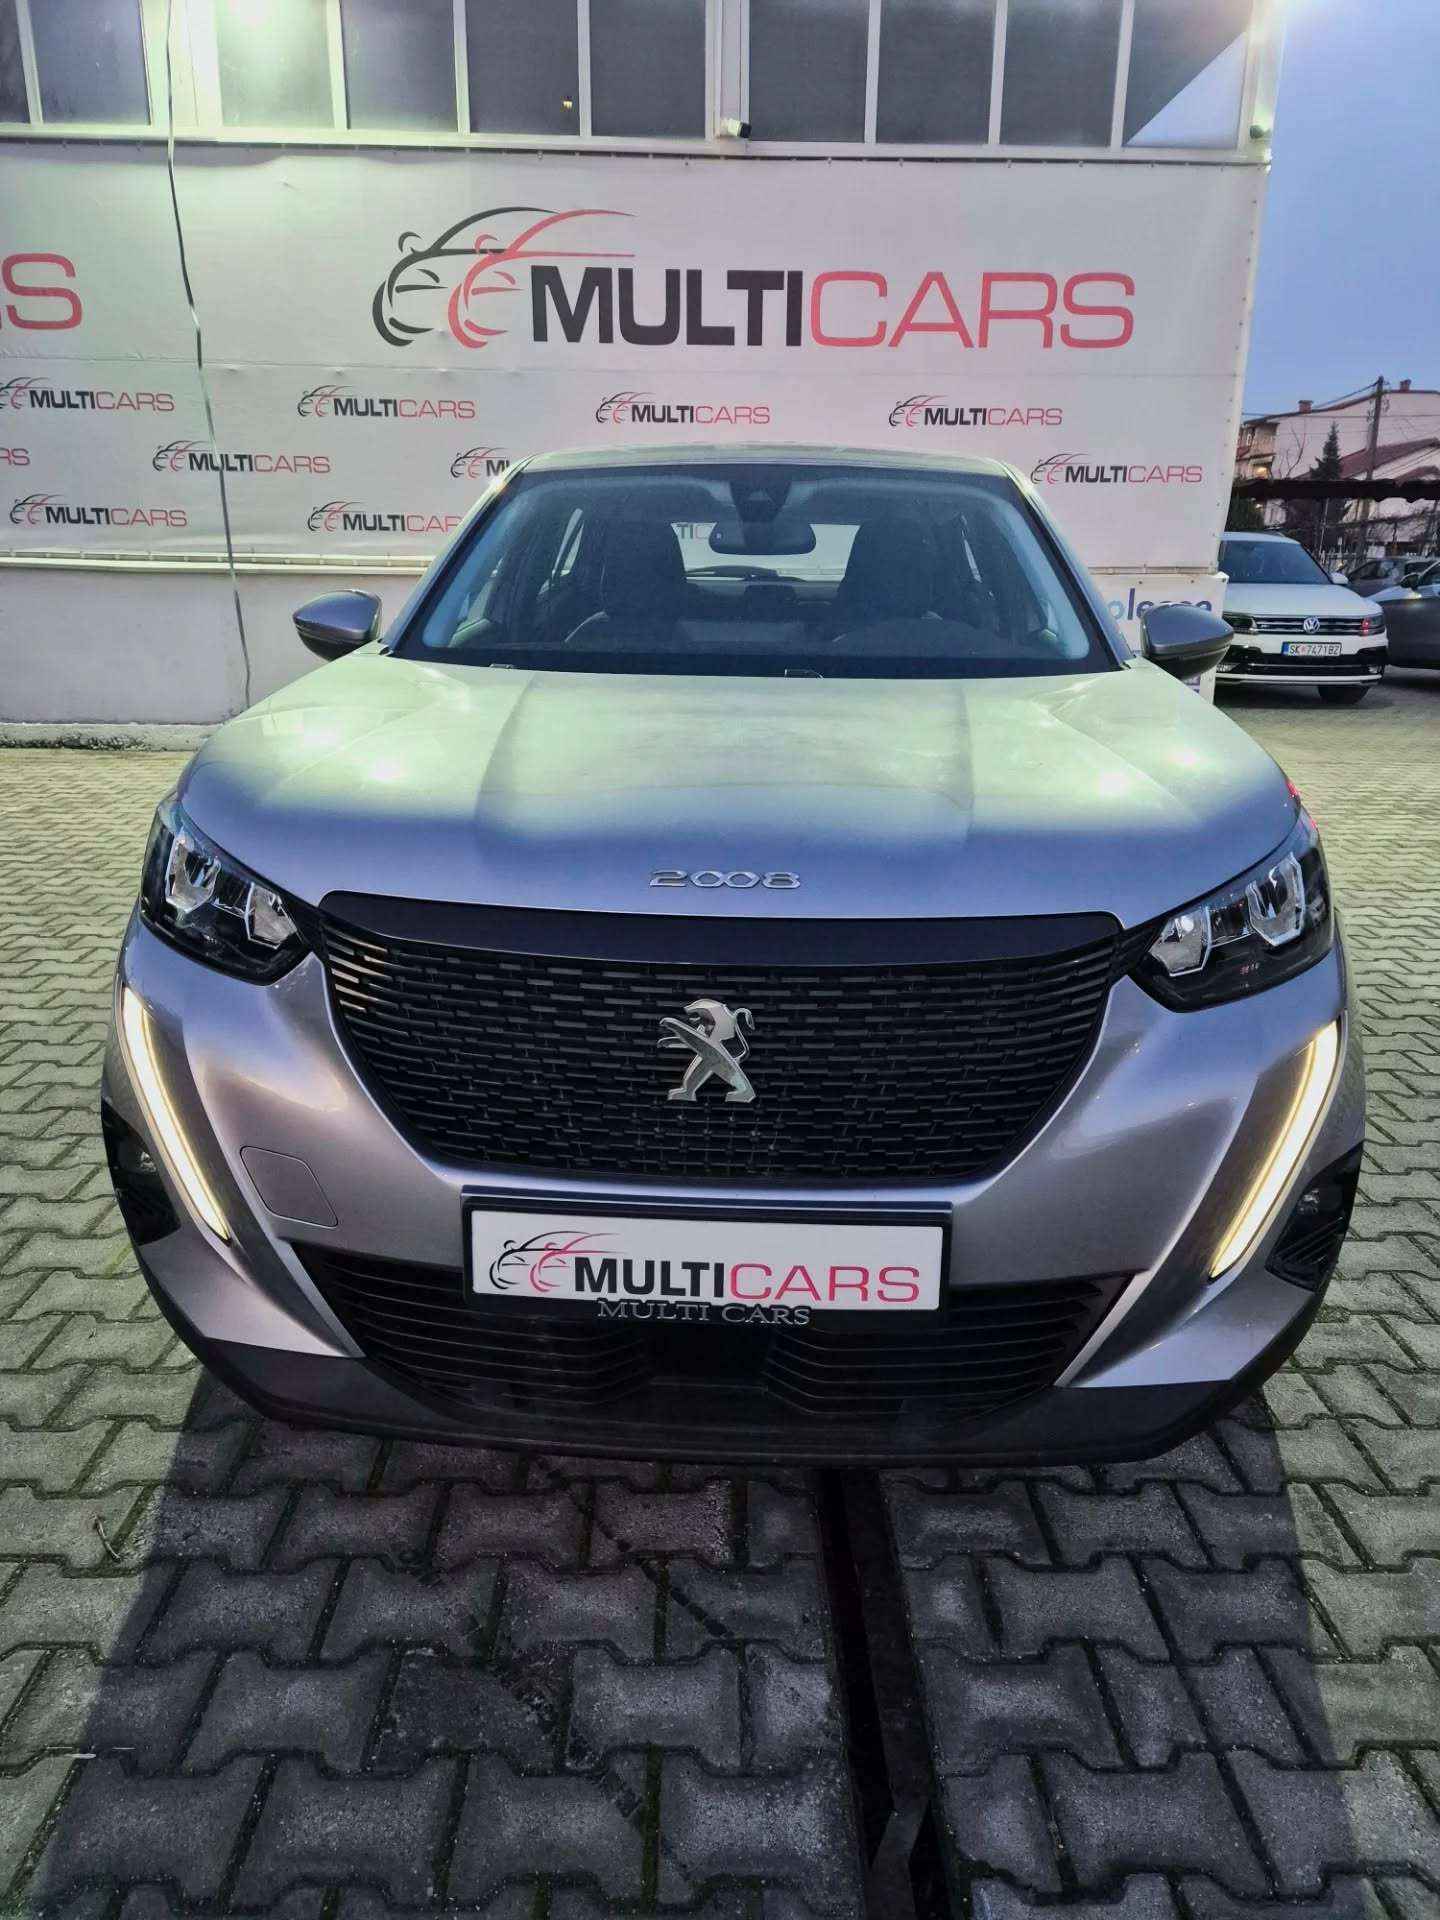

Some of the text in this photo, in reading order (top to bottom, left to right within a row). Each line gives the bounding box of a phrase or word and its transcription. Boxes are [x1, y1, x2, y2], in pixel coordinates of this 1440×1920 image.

[0, 253, 82, 330] S
[530, 265, 1135, 348] MULTICARS
[30, 390, 174, 412] MULTICARS
[333, 398, 475, 419] MULTICARS
[631, 404, 770, 425] MULTICARS
[924, 408, 1062, 426] MULTICARS
[189, 452, 330, 473] MULTICARS
[1064, 464, 1202, 483] MULTICARS
[45, 507, 187, 527] MULTICARS
[650, 870, 801, 889] 2008
[575, 1257, 920, 1302] MULTICARS
[597, 1300, 812, 1326] MULTI CARS
